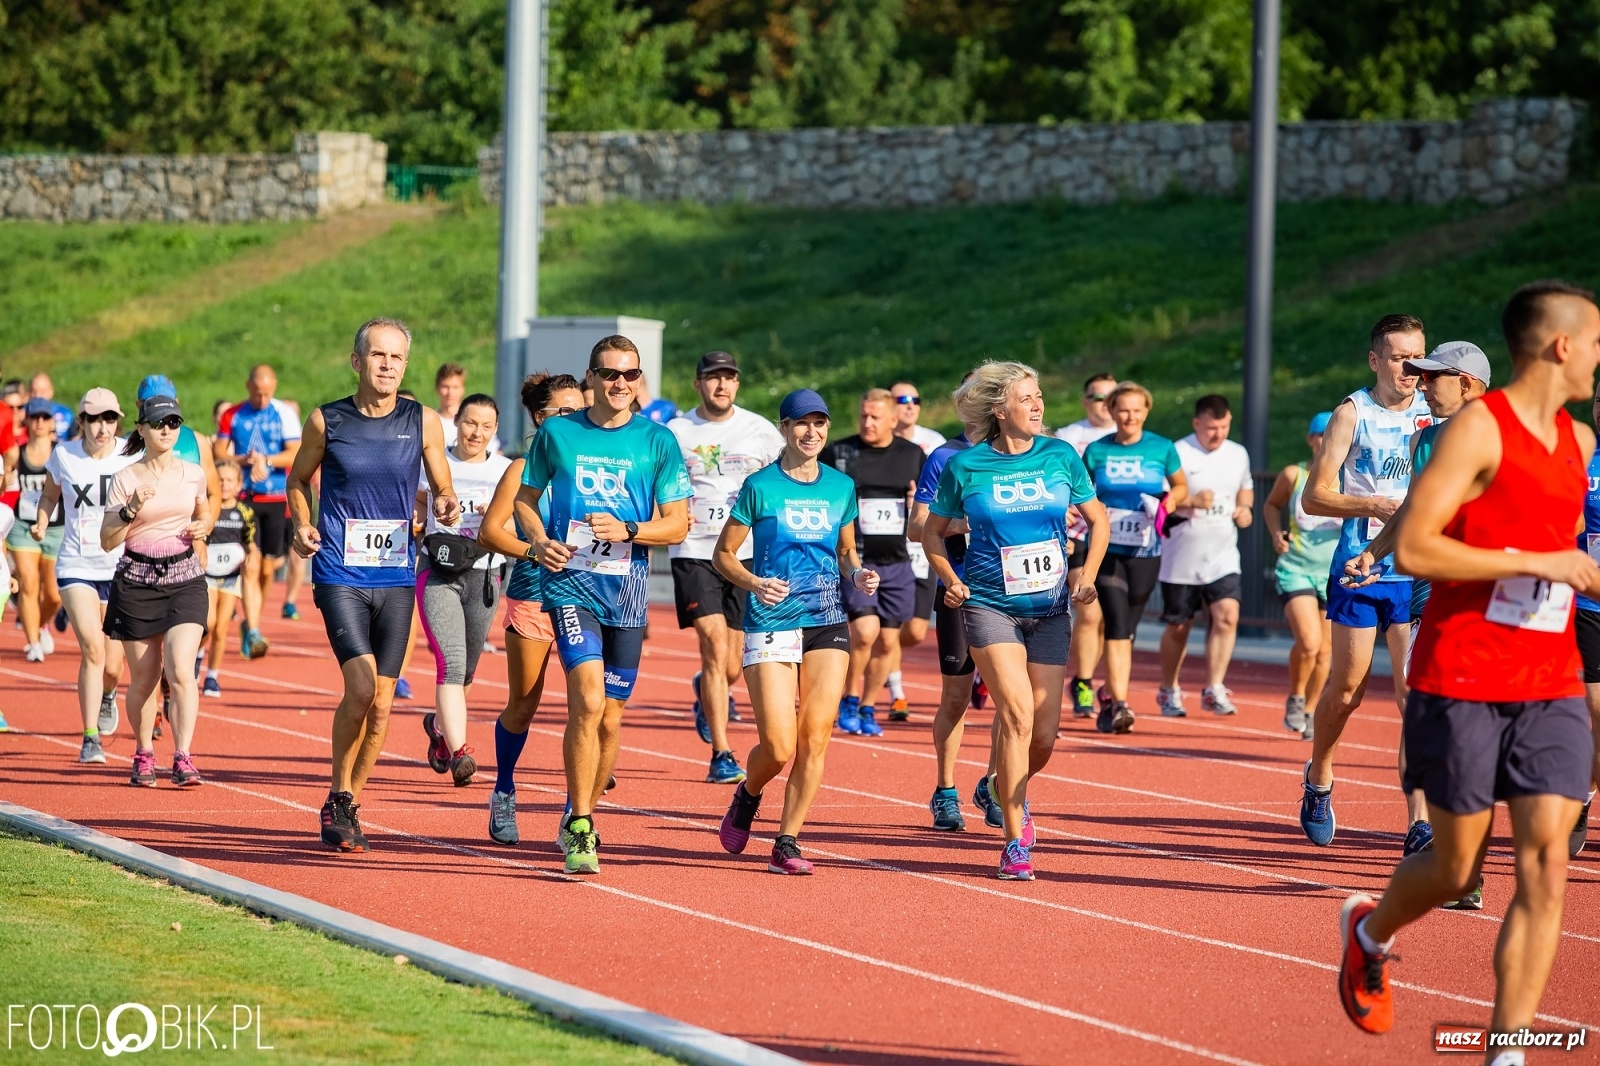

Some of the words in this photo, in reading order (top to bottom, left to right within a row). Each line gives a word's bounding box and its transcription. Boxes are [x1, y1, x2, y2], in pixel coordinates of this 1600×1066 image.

[1105, 460, 1144, 479] bbl
[576, 466, 629, 498] bbl
[993, 477, 1055, 505] bbl
[585, 499, 620, 509] RACIBÓRZ
[1006, 504, 1045, 514] RACIBÓRZ
[709, 507, 724, 520] 73
[785, 508, 832, 531] bbl
[877, 510, 892, 520] 79
[1119, 520, 1141, 533] 135
[365, 533, 393, 550] 106
[591, 539, 612, 557] 72
[1023, 555, 1051, 575] 118
